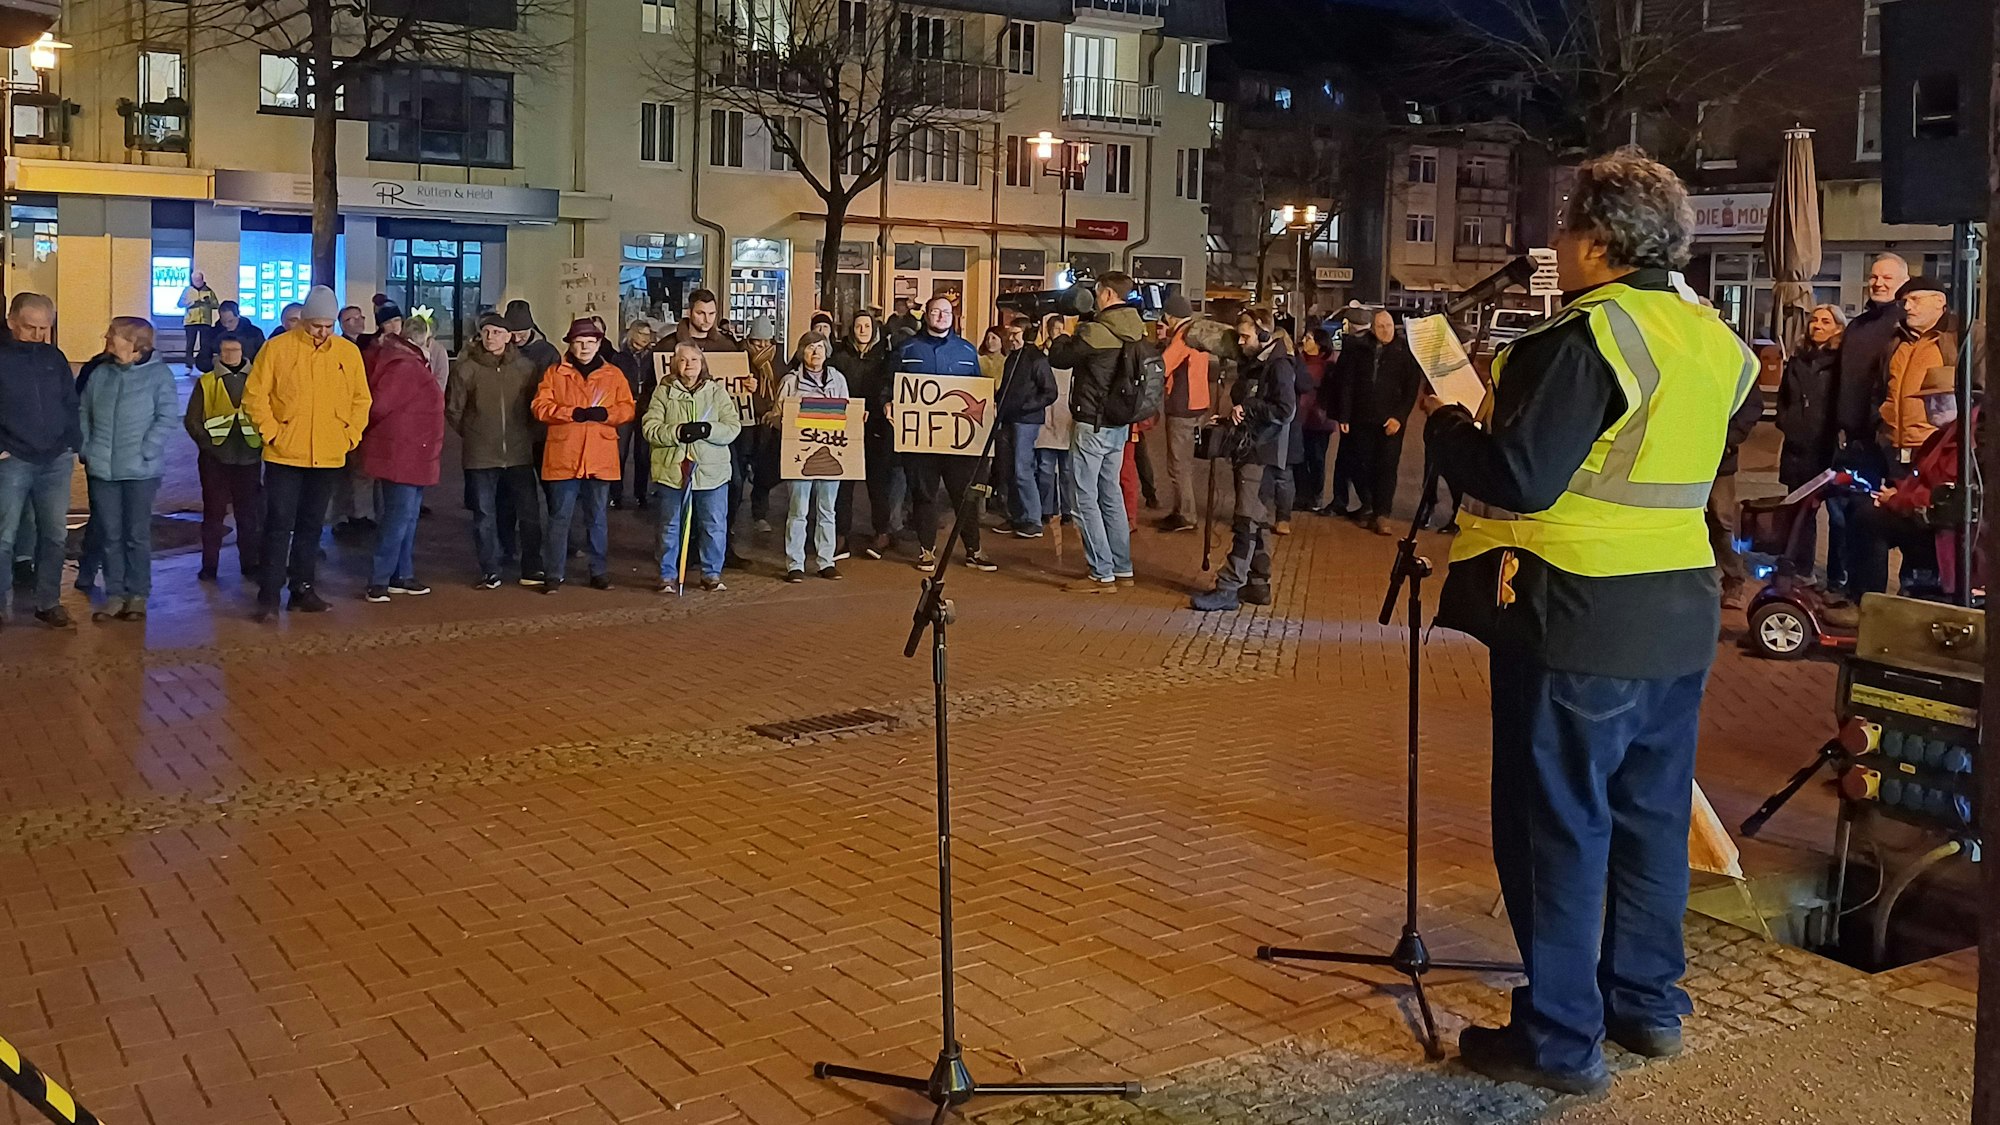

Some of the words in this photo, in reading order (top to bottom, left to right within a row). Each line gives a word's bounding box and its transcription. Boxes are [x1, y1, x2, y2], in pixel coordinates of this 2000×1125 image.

[454, 188, 464, 199] &
[1696, 207, 1720, 225] DIE
[1738, 203, 1769, 224] MÖH
[899, 376, 941, 405] NO
[799, 427, 849, 447] Statt
[902, 410, 976, 449] AFD
